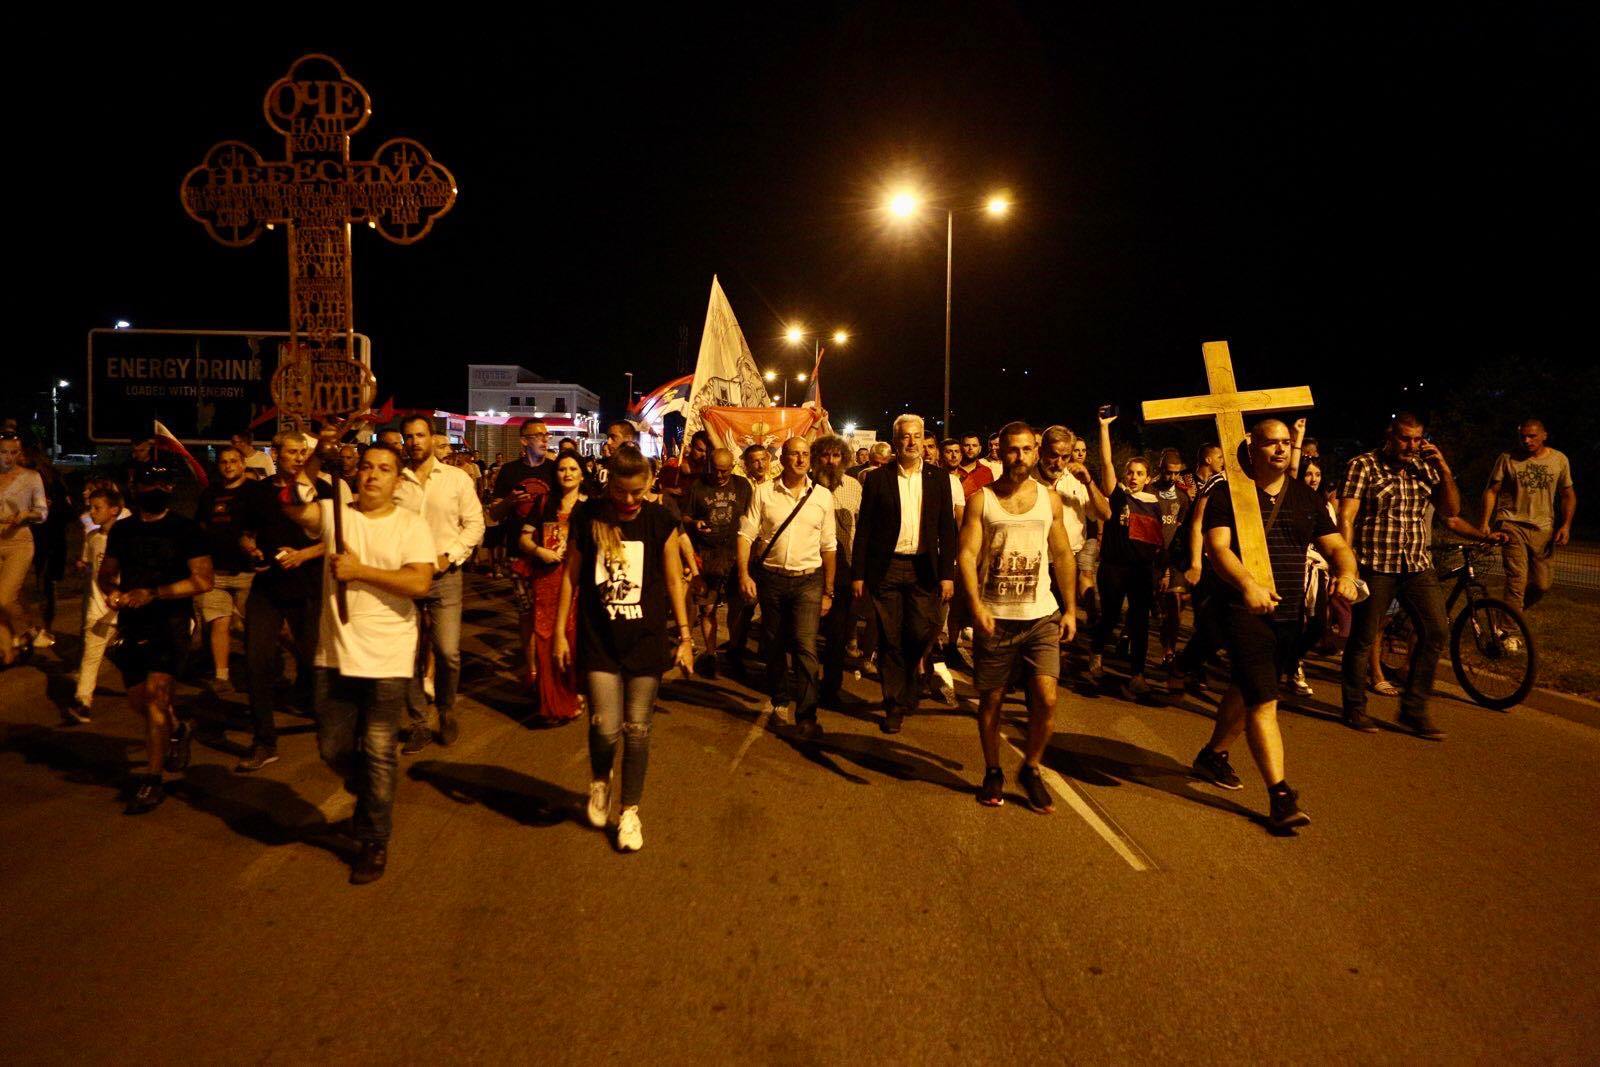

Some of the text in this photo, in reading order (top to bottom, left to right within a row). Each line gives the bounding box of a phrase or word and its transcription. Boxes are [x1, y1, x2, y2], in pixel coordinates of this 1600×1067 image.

[271, 80, 359, 119] ОЧЕ
[291, 118, 345, 135] НАШ
[208, 159, 440, 186] НЕБЕСИМА
[106, 357, 263, 381] ENERGY DRINK
[168, 385, 197, 397] WITH
[606, 604, 644, 621] УЧИ
